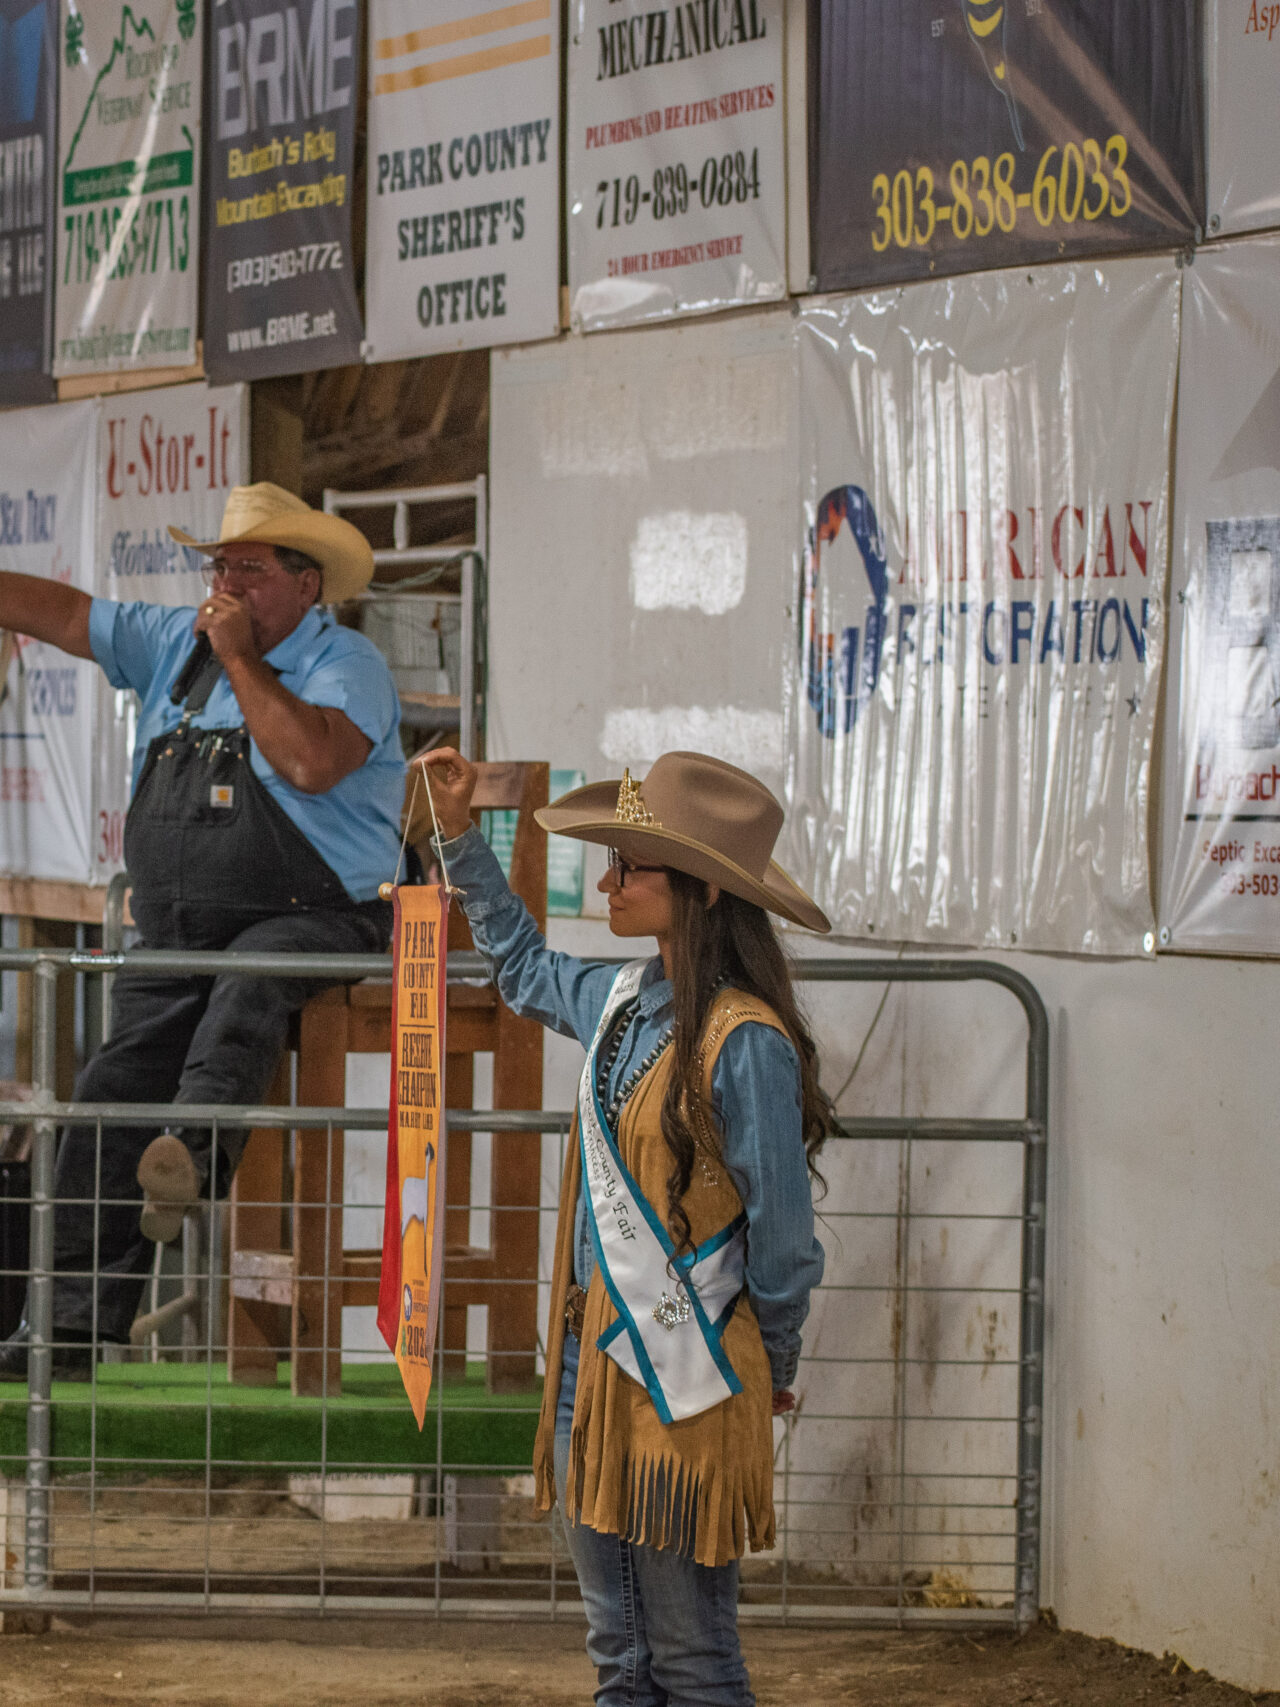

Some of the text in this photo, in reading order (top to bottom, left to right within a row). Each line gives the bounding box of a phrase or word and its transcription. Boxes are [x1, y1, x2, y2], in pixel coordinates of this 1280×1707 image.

[217, 0, 358, 141] BRME
[597, 0, 767, 82] MECHANICAL
[664, 98, 718, 131] HEATING
[720, 83, 775, 119] SERVICES
[377, 117, 552, 196] PARK COUNTY
[596, 147, 761, 231] 719-839-0884
[871, 134, 1133, 252] 303-838-6033
[398, 197, 526, 261] SHERIFF'S
[418, 273, 507, 328] OFFICE
[106, 406, 231, 499] U-Stor-It
[403, 921, 436, 959] PARK
[403, 962, 435, 989] COUNTY
[595, 1137, 618, 1199] County
[612, 1201, 637, 1242] Fair
